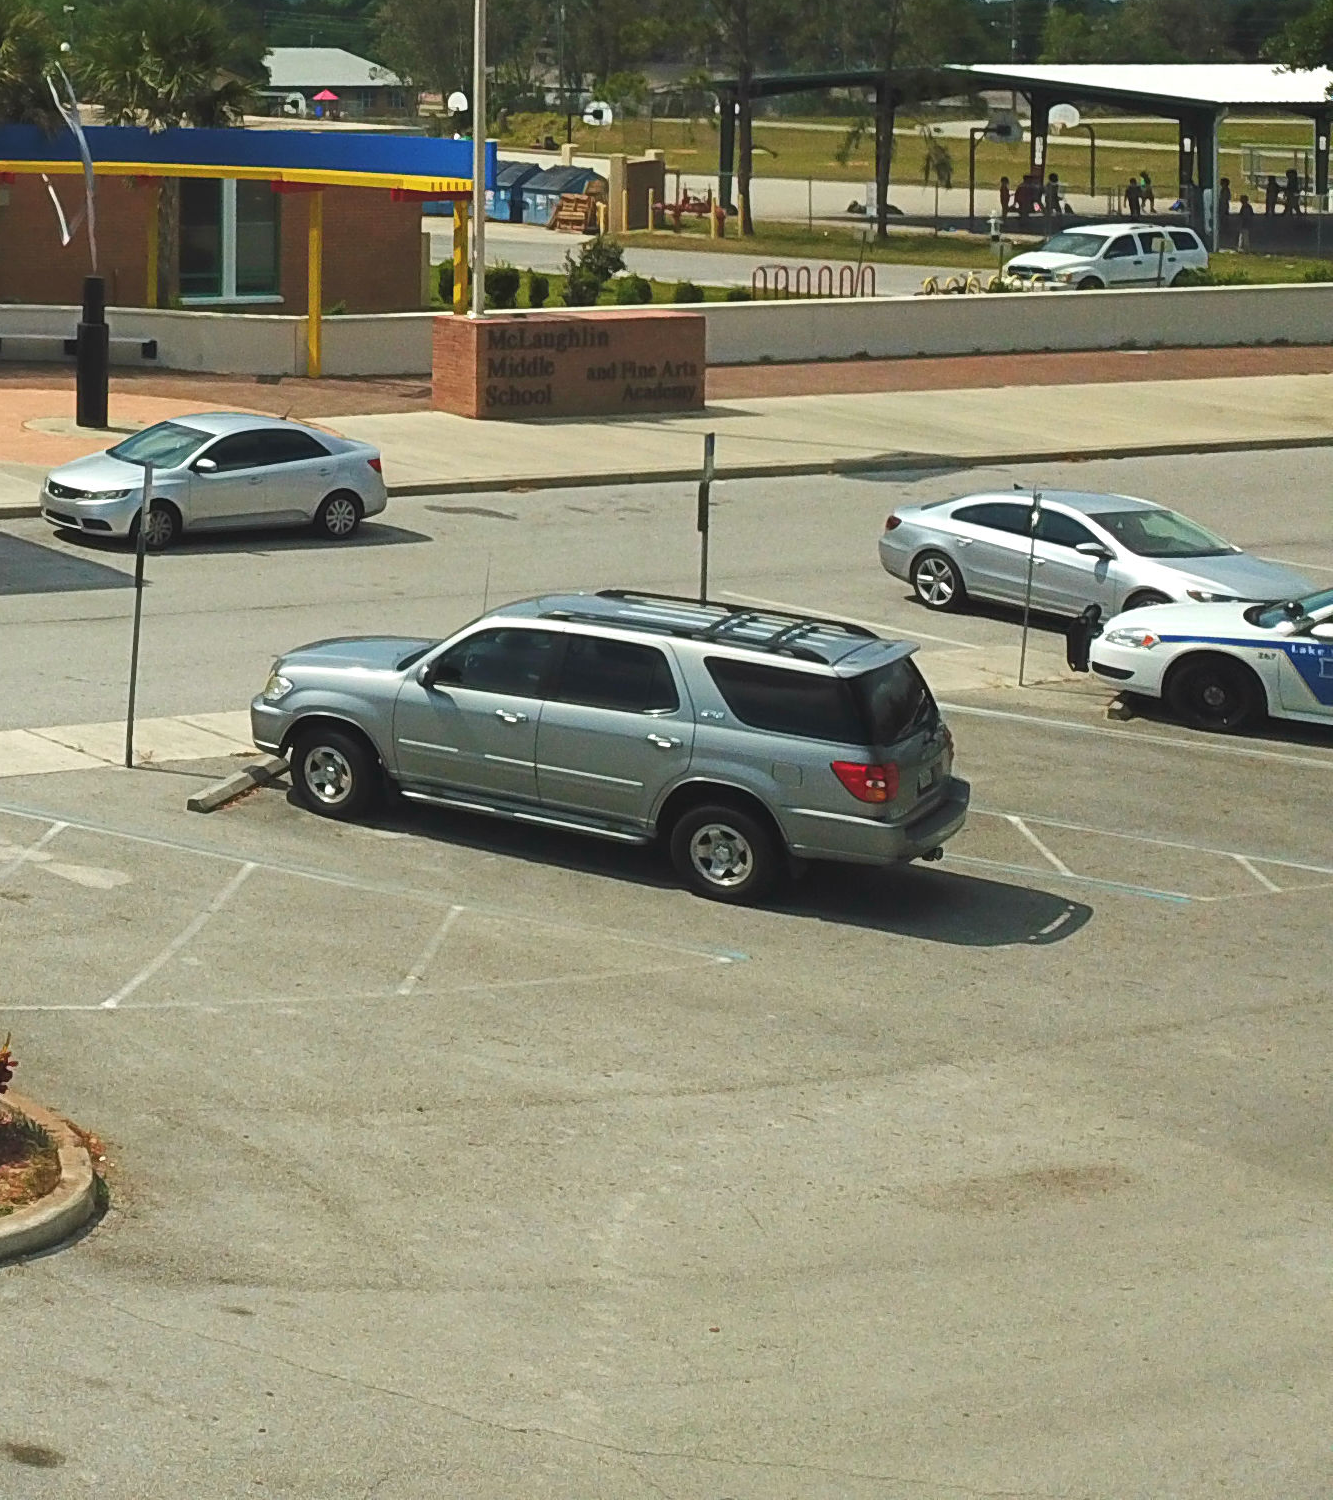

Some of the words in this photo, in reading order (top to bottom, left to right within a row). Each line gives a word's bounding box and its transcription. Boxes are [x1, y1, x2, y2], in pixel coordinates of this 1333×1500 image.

[487, 327, 610, 350] McLaughlin
[487, 356, 555, 378] Middle
[587, 363, 616, 381] and
[621, 361, 656, 380] Fine
[662, 360, 696, 377] Arts
[485, 384, 552, 407] School
[623, 381, 696, 401] Academy
[1291, 644, 1325, 656] Lake
